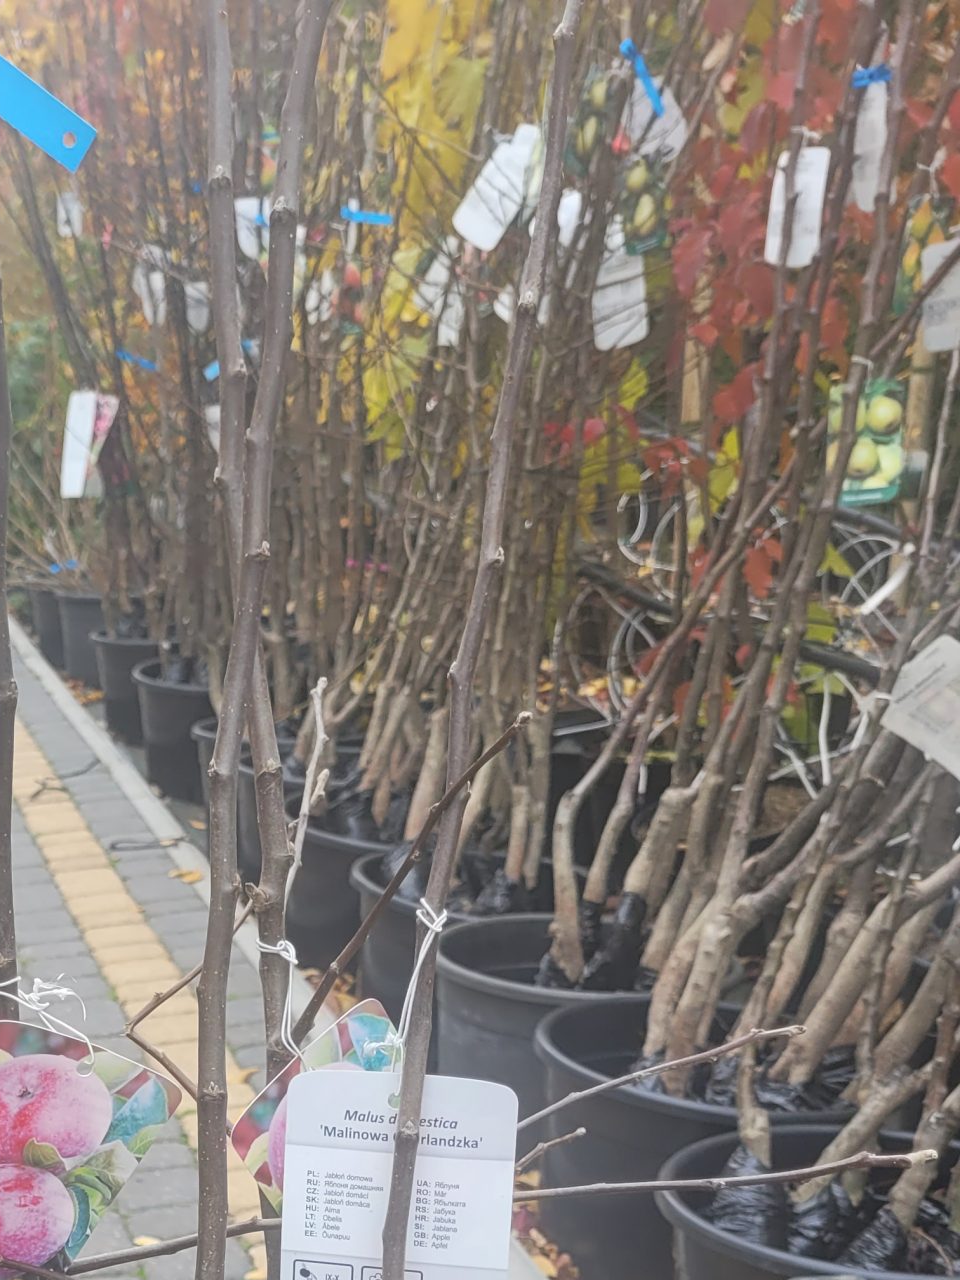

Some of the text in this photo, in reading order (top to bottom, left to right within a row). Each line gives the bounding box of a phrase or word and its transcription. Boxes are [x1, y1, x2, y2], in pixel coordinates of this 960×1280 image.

[344, 1109, 458, 1130] Malus destica
[320, 1124, 483, 1149] 'Malinowa rlandzka'
[307, 1170, 319, 1178] PL:
[306, 1187, 319, 1195] CZ:
[416, 1197, 431, 1205] BG:
[305, 1204, 319, 1212] HU:
[414, 1214, 429, 1222] HR:
[304, 1221, 316, 1229] LV:
